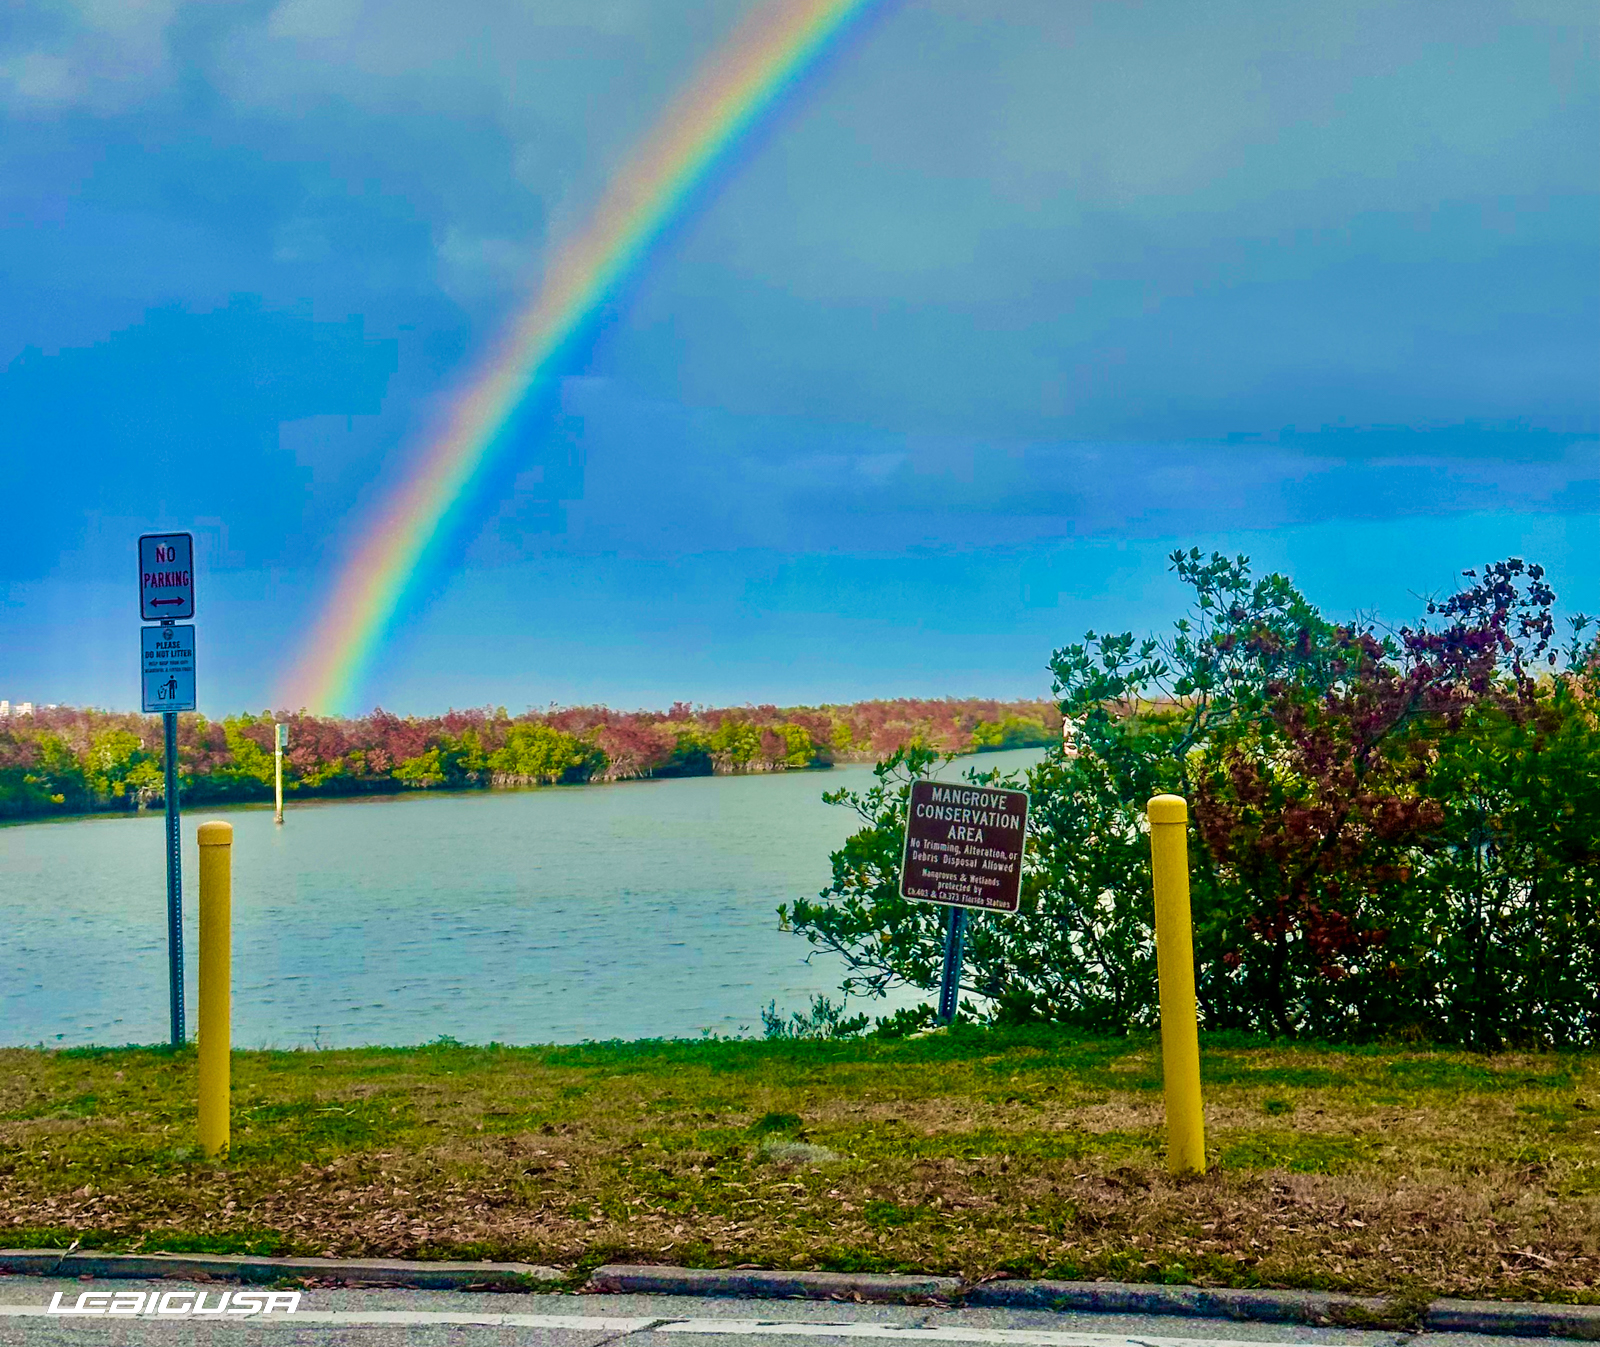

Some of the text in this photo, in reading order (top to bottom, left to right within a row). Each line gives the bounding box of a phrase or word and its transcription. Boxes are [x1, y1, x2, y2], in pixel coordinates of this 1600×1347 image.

[156, 547, 176, 563] NO
[144, 570, 189, 589] PARKING
[145, 649, 192, 659] DO NOT LITTER
[156, 641, 180, 649] PLEASE
[932, 787, 1008, 810] MANGROVE
[917, 803, 1020, 830] CONSERVATION
[947, 825, 983, 843] AREA
[910, 837, 1018, 860] No Trimming, Alteration, or
[912, 850, 1014, 873] Debris Disposal Allowed
[922, 868, 1000, 887] Mangroves & Wetlands
[930, 890, 937, 899] &
[962, 894, 984, 905] Florida
[937, 881, 982, 896] protected by
